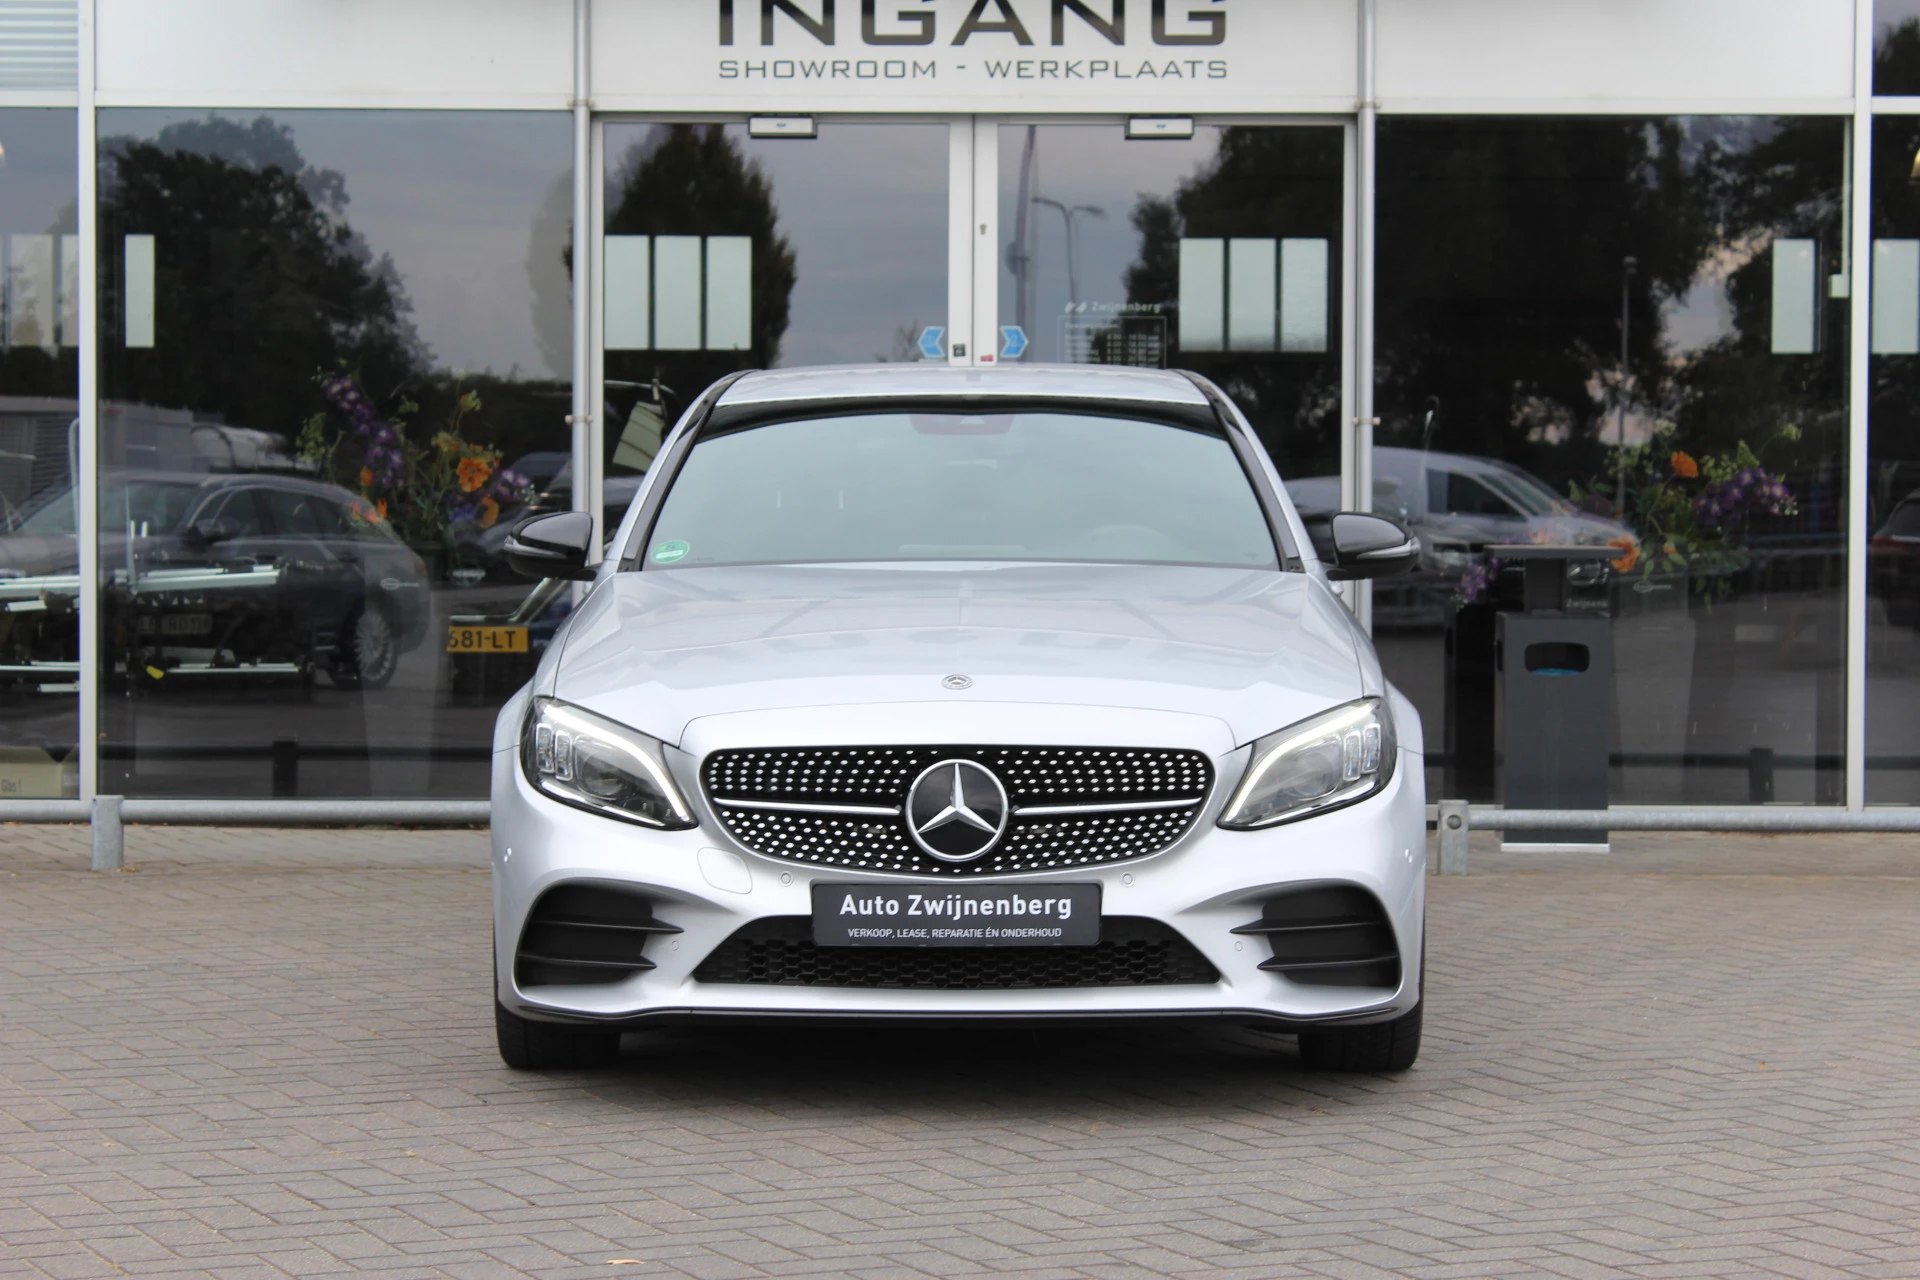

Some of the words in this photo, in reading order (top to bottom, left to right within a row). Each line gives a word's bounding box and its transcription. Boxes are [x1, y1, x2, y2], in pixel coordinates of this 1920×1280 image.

[717, 0, 1227, 47] INGANG
[718, 60, 937, 79] SHOWROOM
[984, 60, 1228, 79] WERKPLAATS
[839, 894, 900, 916] Auto
[907, 894, 1072, 919] Zwijnenberg
[848, 928, 895, 939] VERKOOP,
[897, 928, 930, 939] LEASE,
[932, 928, 984, 938] REPARATIE
[985, 926, 999, 938] ÉN
[1001, 928, 1062, 938] ONDERHOUD
